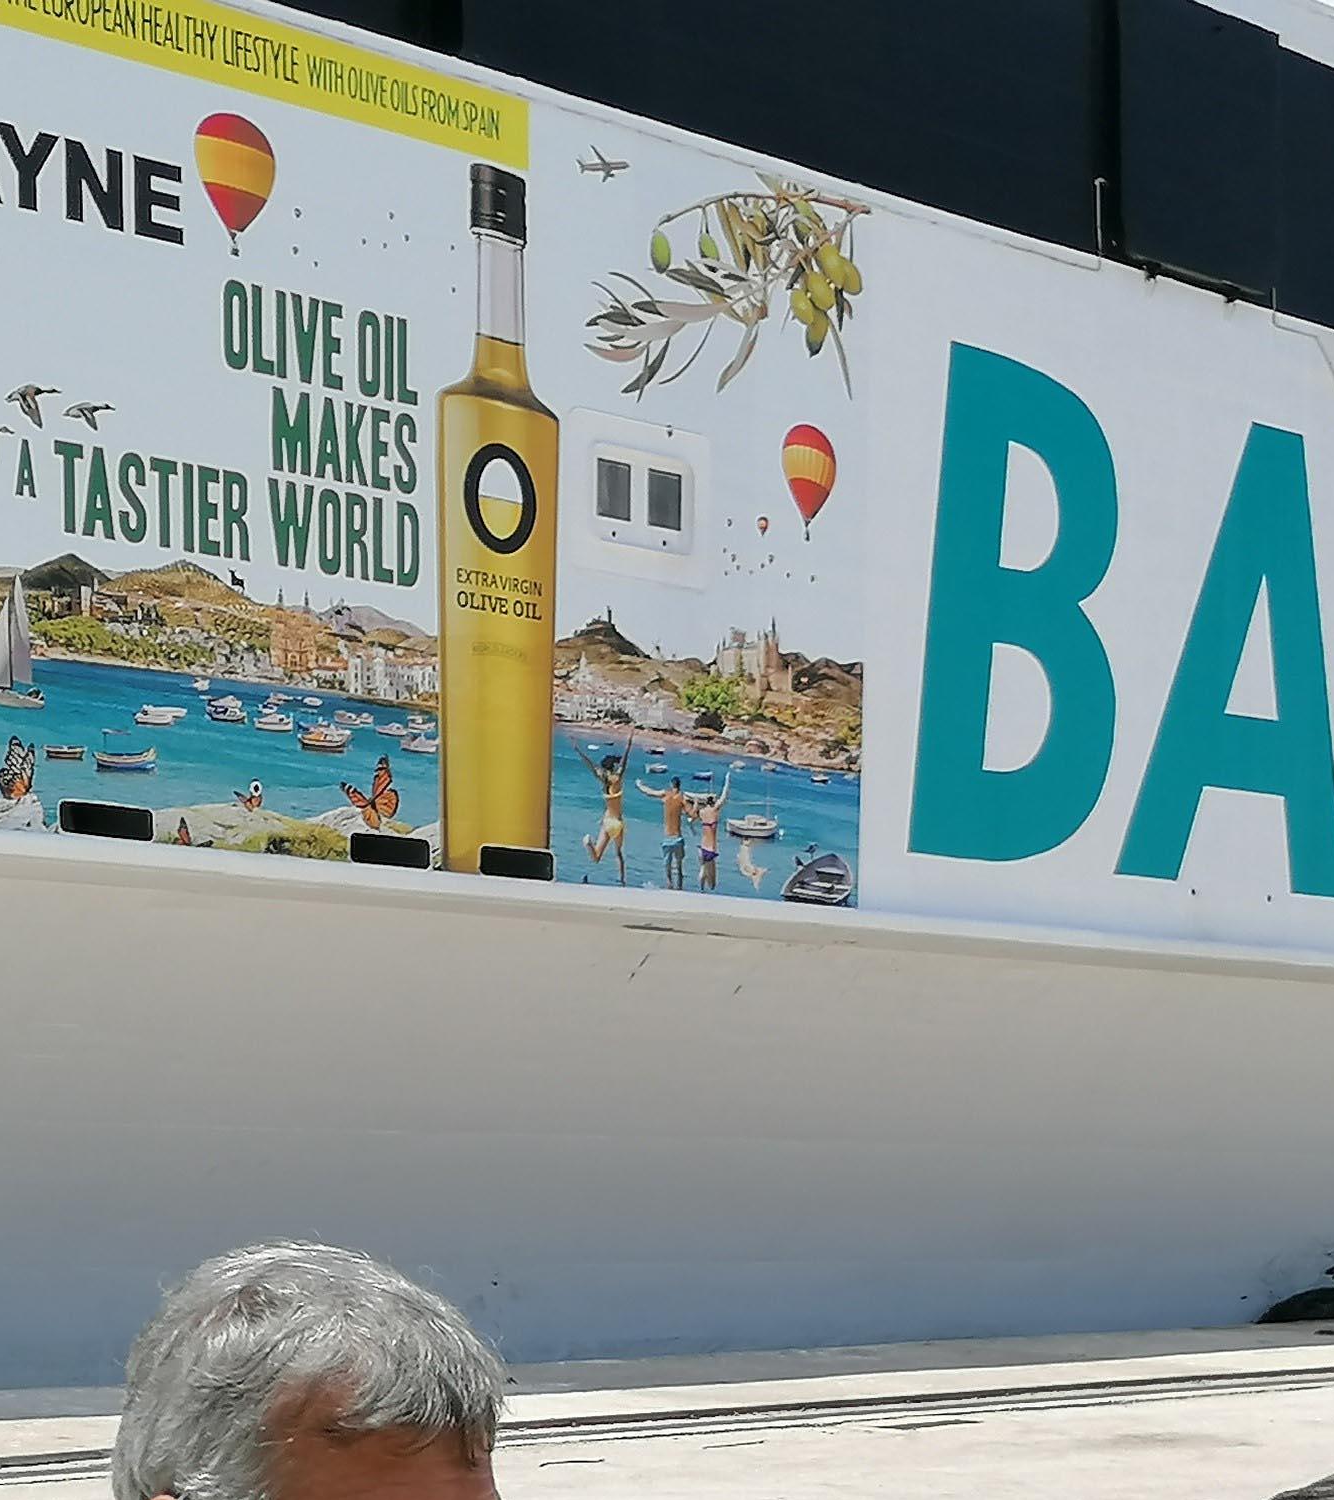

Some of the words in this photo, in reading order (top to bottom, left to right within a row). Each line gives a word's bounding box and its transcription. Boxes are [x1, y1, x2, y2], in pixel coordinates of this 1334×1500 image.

[140, 7, 218, 61] HEALTHY
[222, 26, 299, 84] LIFESTYLE
[306, 53, 345, 96] WITH
[347, 66, 386, 108] OLIVE
[389, 79, 418, 116] OILS
[420, 88, 461, 128] FROM
[462, 101, 500, 140] SPAIN
[223, 279, 344, 391] OLIVE
[357, 310, 418, 406] OIL
[271, 386, 418, 495] MAKES
[15, 438, 36, 499] A
[54, 440, 250, 561] TASTIER
[267, 477, 419, 588] WORLD
[457, 591, 508, 615] OLIVE
[513, 600, 542, 620] OIL
